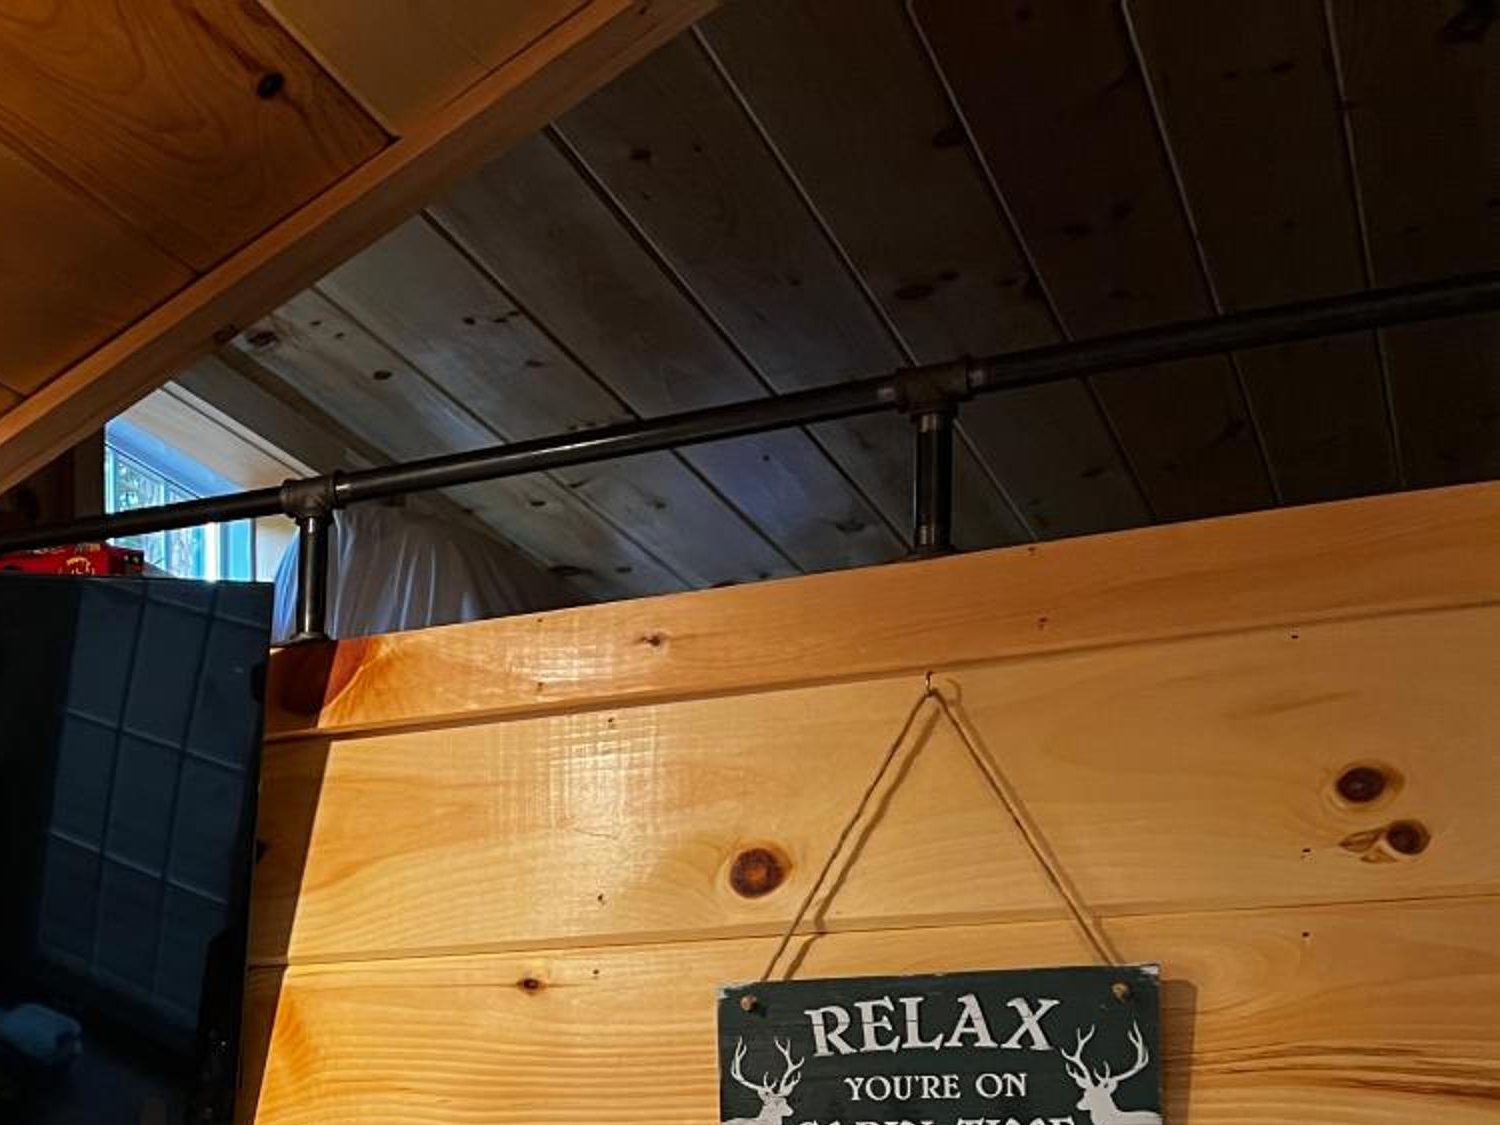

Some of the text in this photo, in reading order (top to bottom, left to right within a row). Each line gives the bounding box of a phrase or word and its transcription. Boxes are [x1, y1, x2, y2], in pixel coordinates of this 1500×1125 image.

[803, 992, 1061, 1058] RELAX
[844, 1072, 1028, 1102] YOU'RE ON
